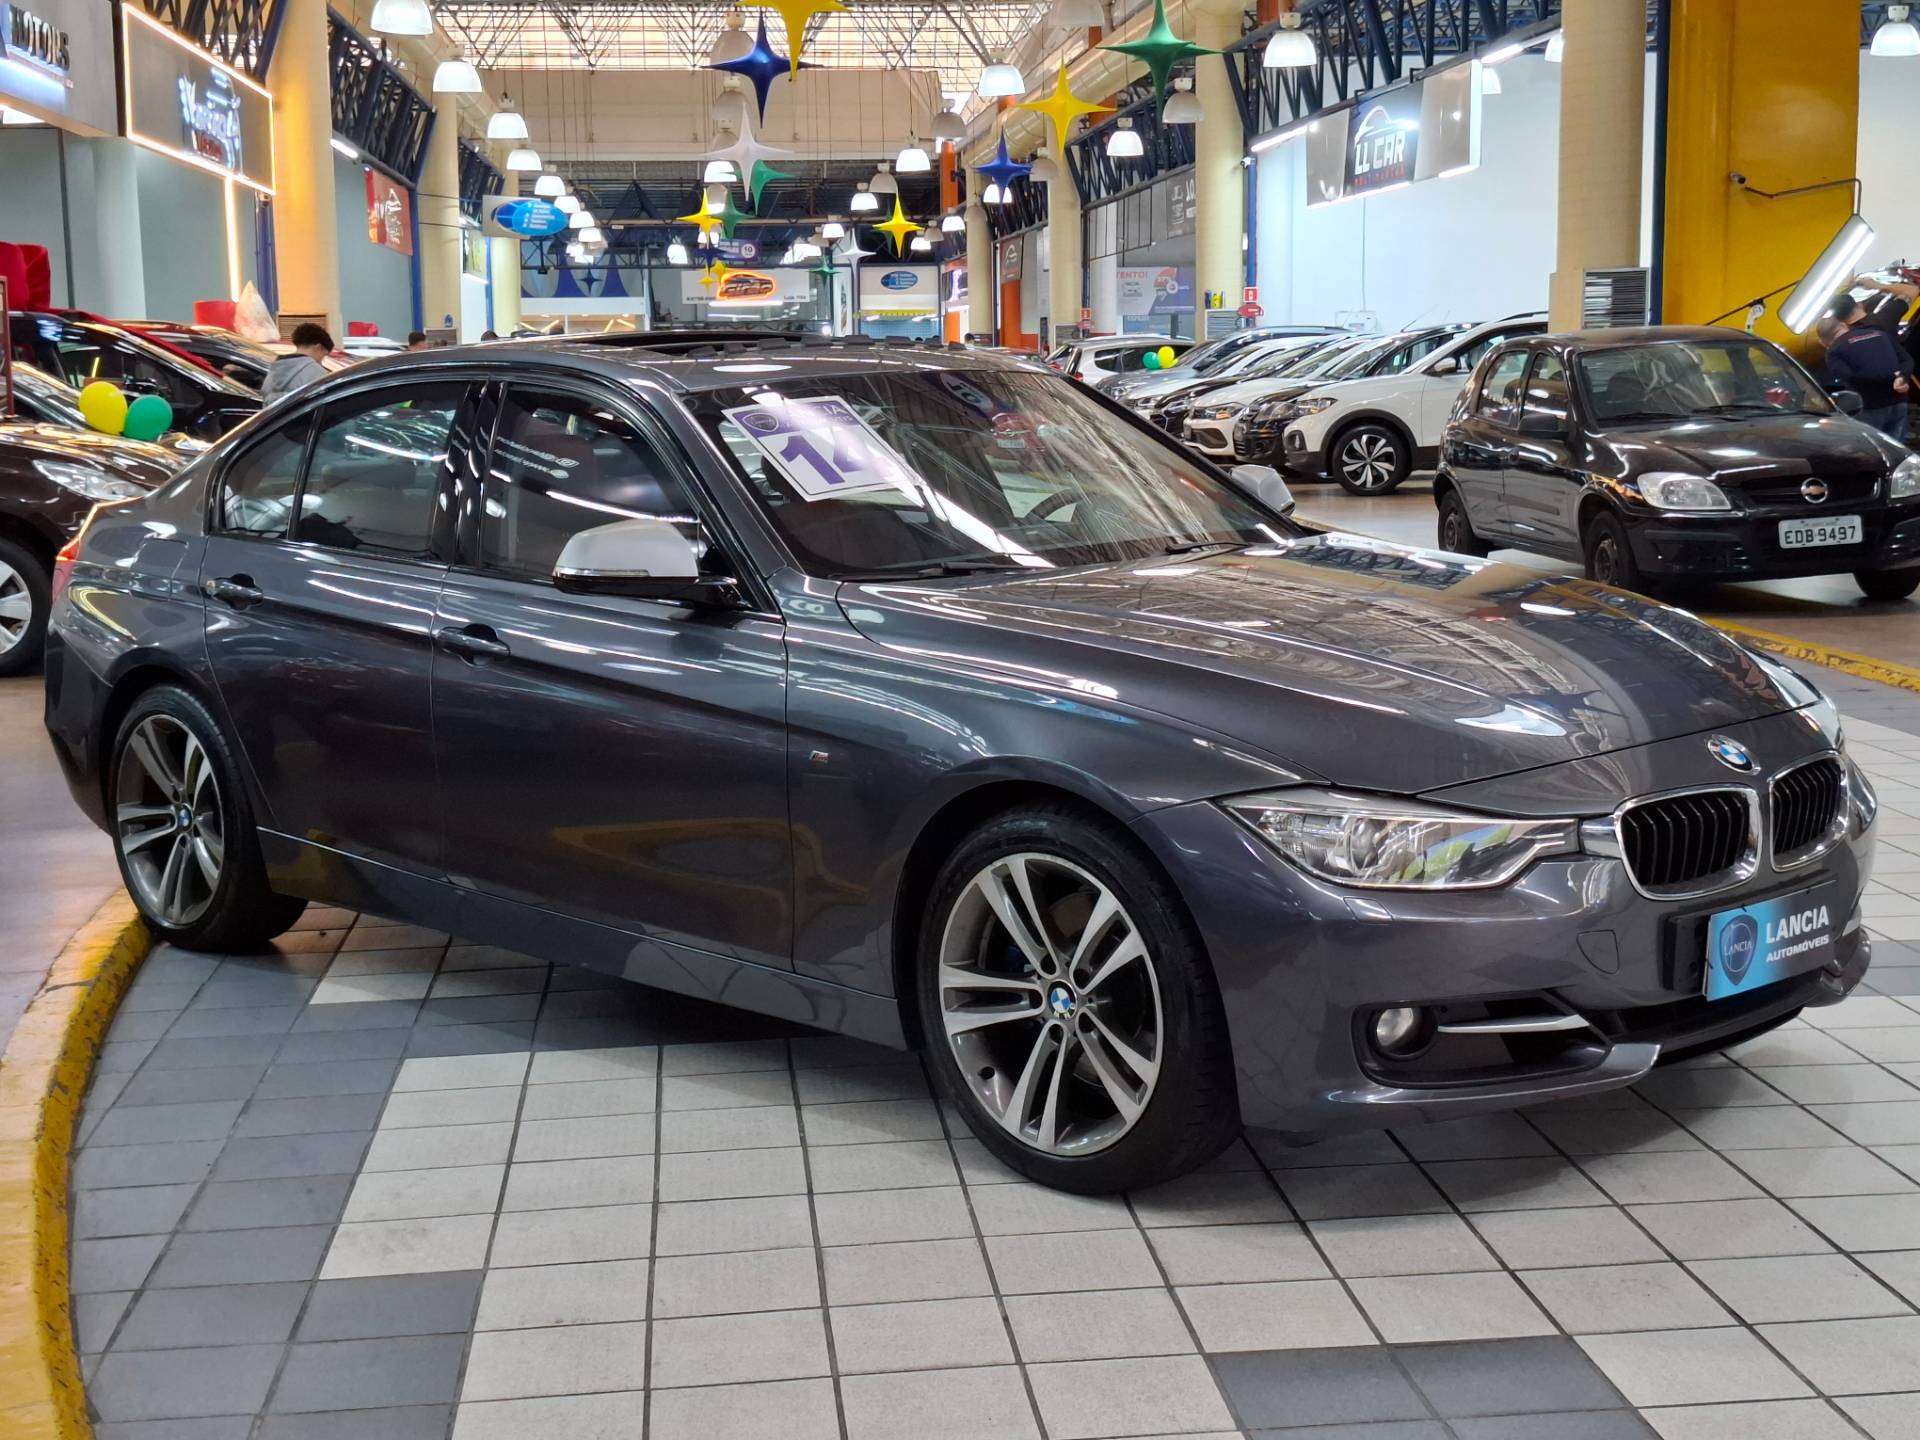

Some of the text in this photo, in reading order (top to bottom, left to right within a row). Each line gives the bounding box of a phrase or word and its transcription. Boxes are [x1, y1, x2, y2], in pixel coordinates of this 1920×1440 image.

[1373, 130, 1406, 169] CAR
[1765, 905, 1830, 944] LANCIA
[1724, 940, 1753, 956] LANCIA
[1765, 934, 1830, 963] AUTOMÓVEIS
